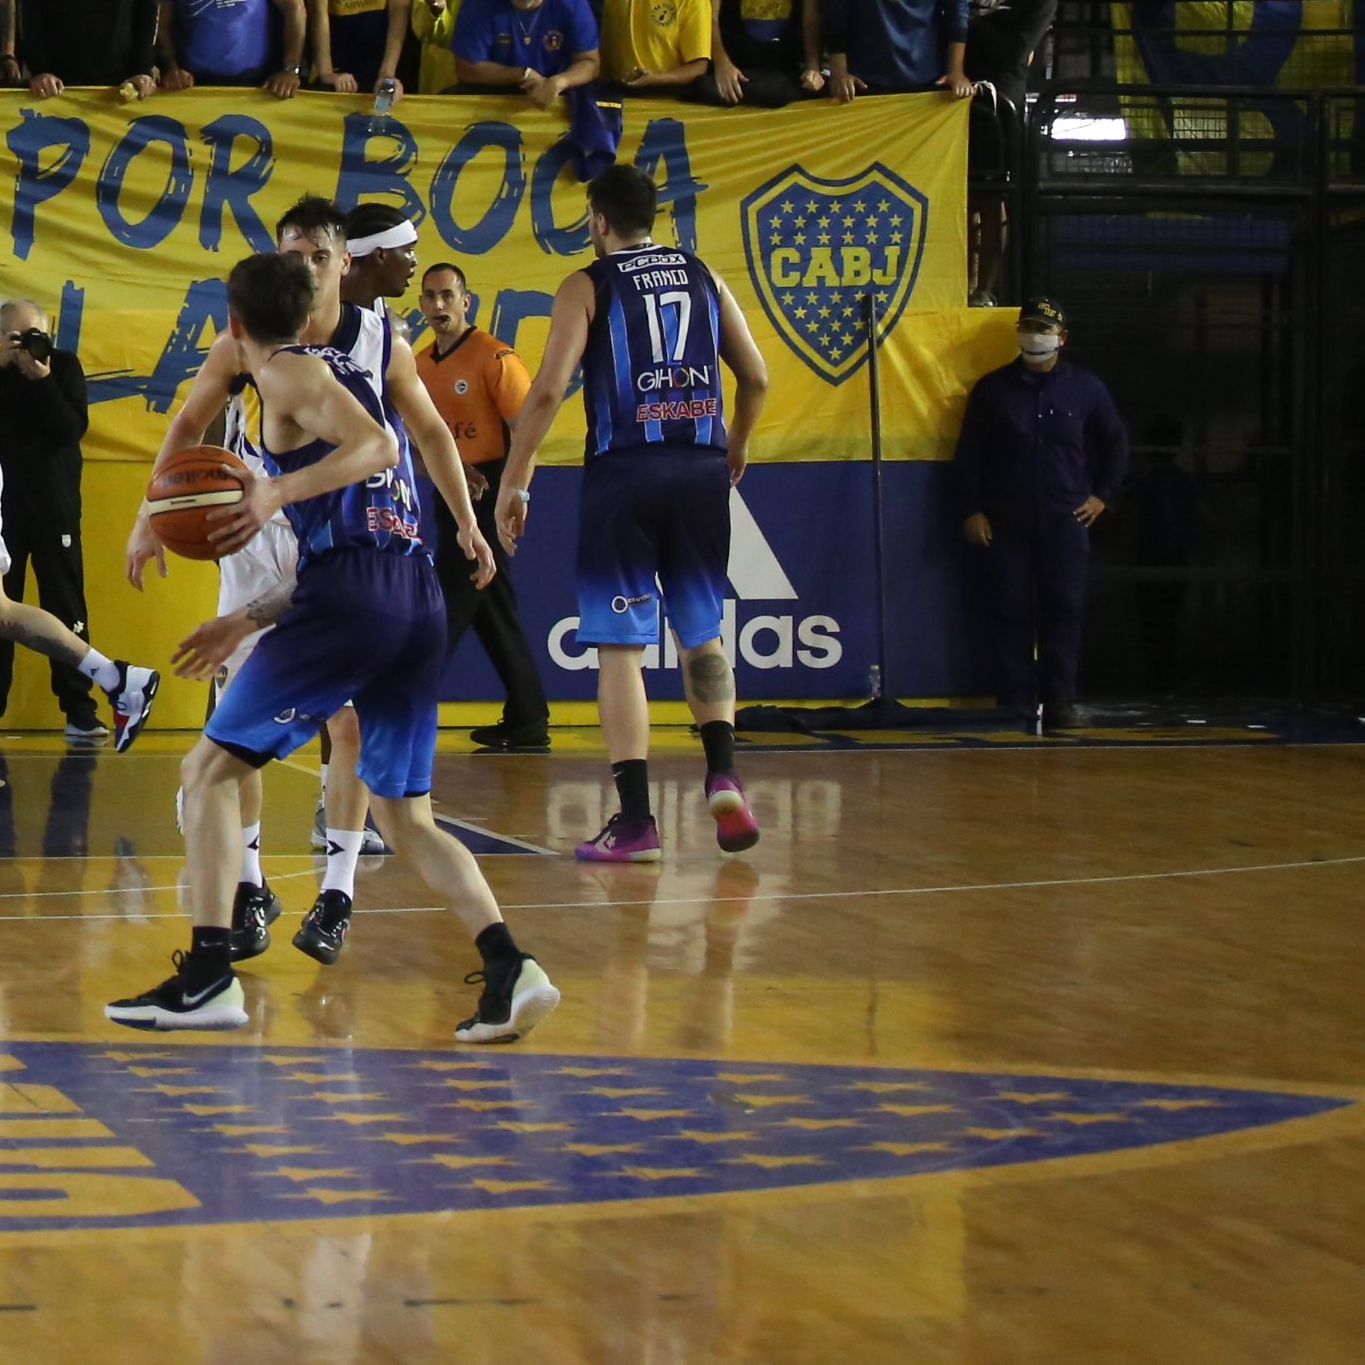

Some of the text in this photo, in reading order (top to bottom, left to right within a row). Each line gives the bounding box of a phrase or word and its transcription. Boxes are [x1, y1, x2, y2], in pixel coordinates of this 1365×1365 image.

[6, 109, 276, 262] POR
[337, 112, 708, 258] BOCA
[632, 269, 690, 291] FRANCO
[771, 245, 901, 288] CABJ
[642, 291, 691, 364] 17
[637, 365, 711, 392] GIHON
[636, 400, 717, 423] ESKABE
